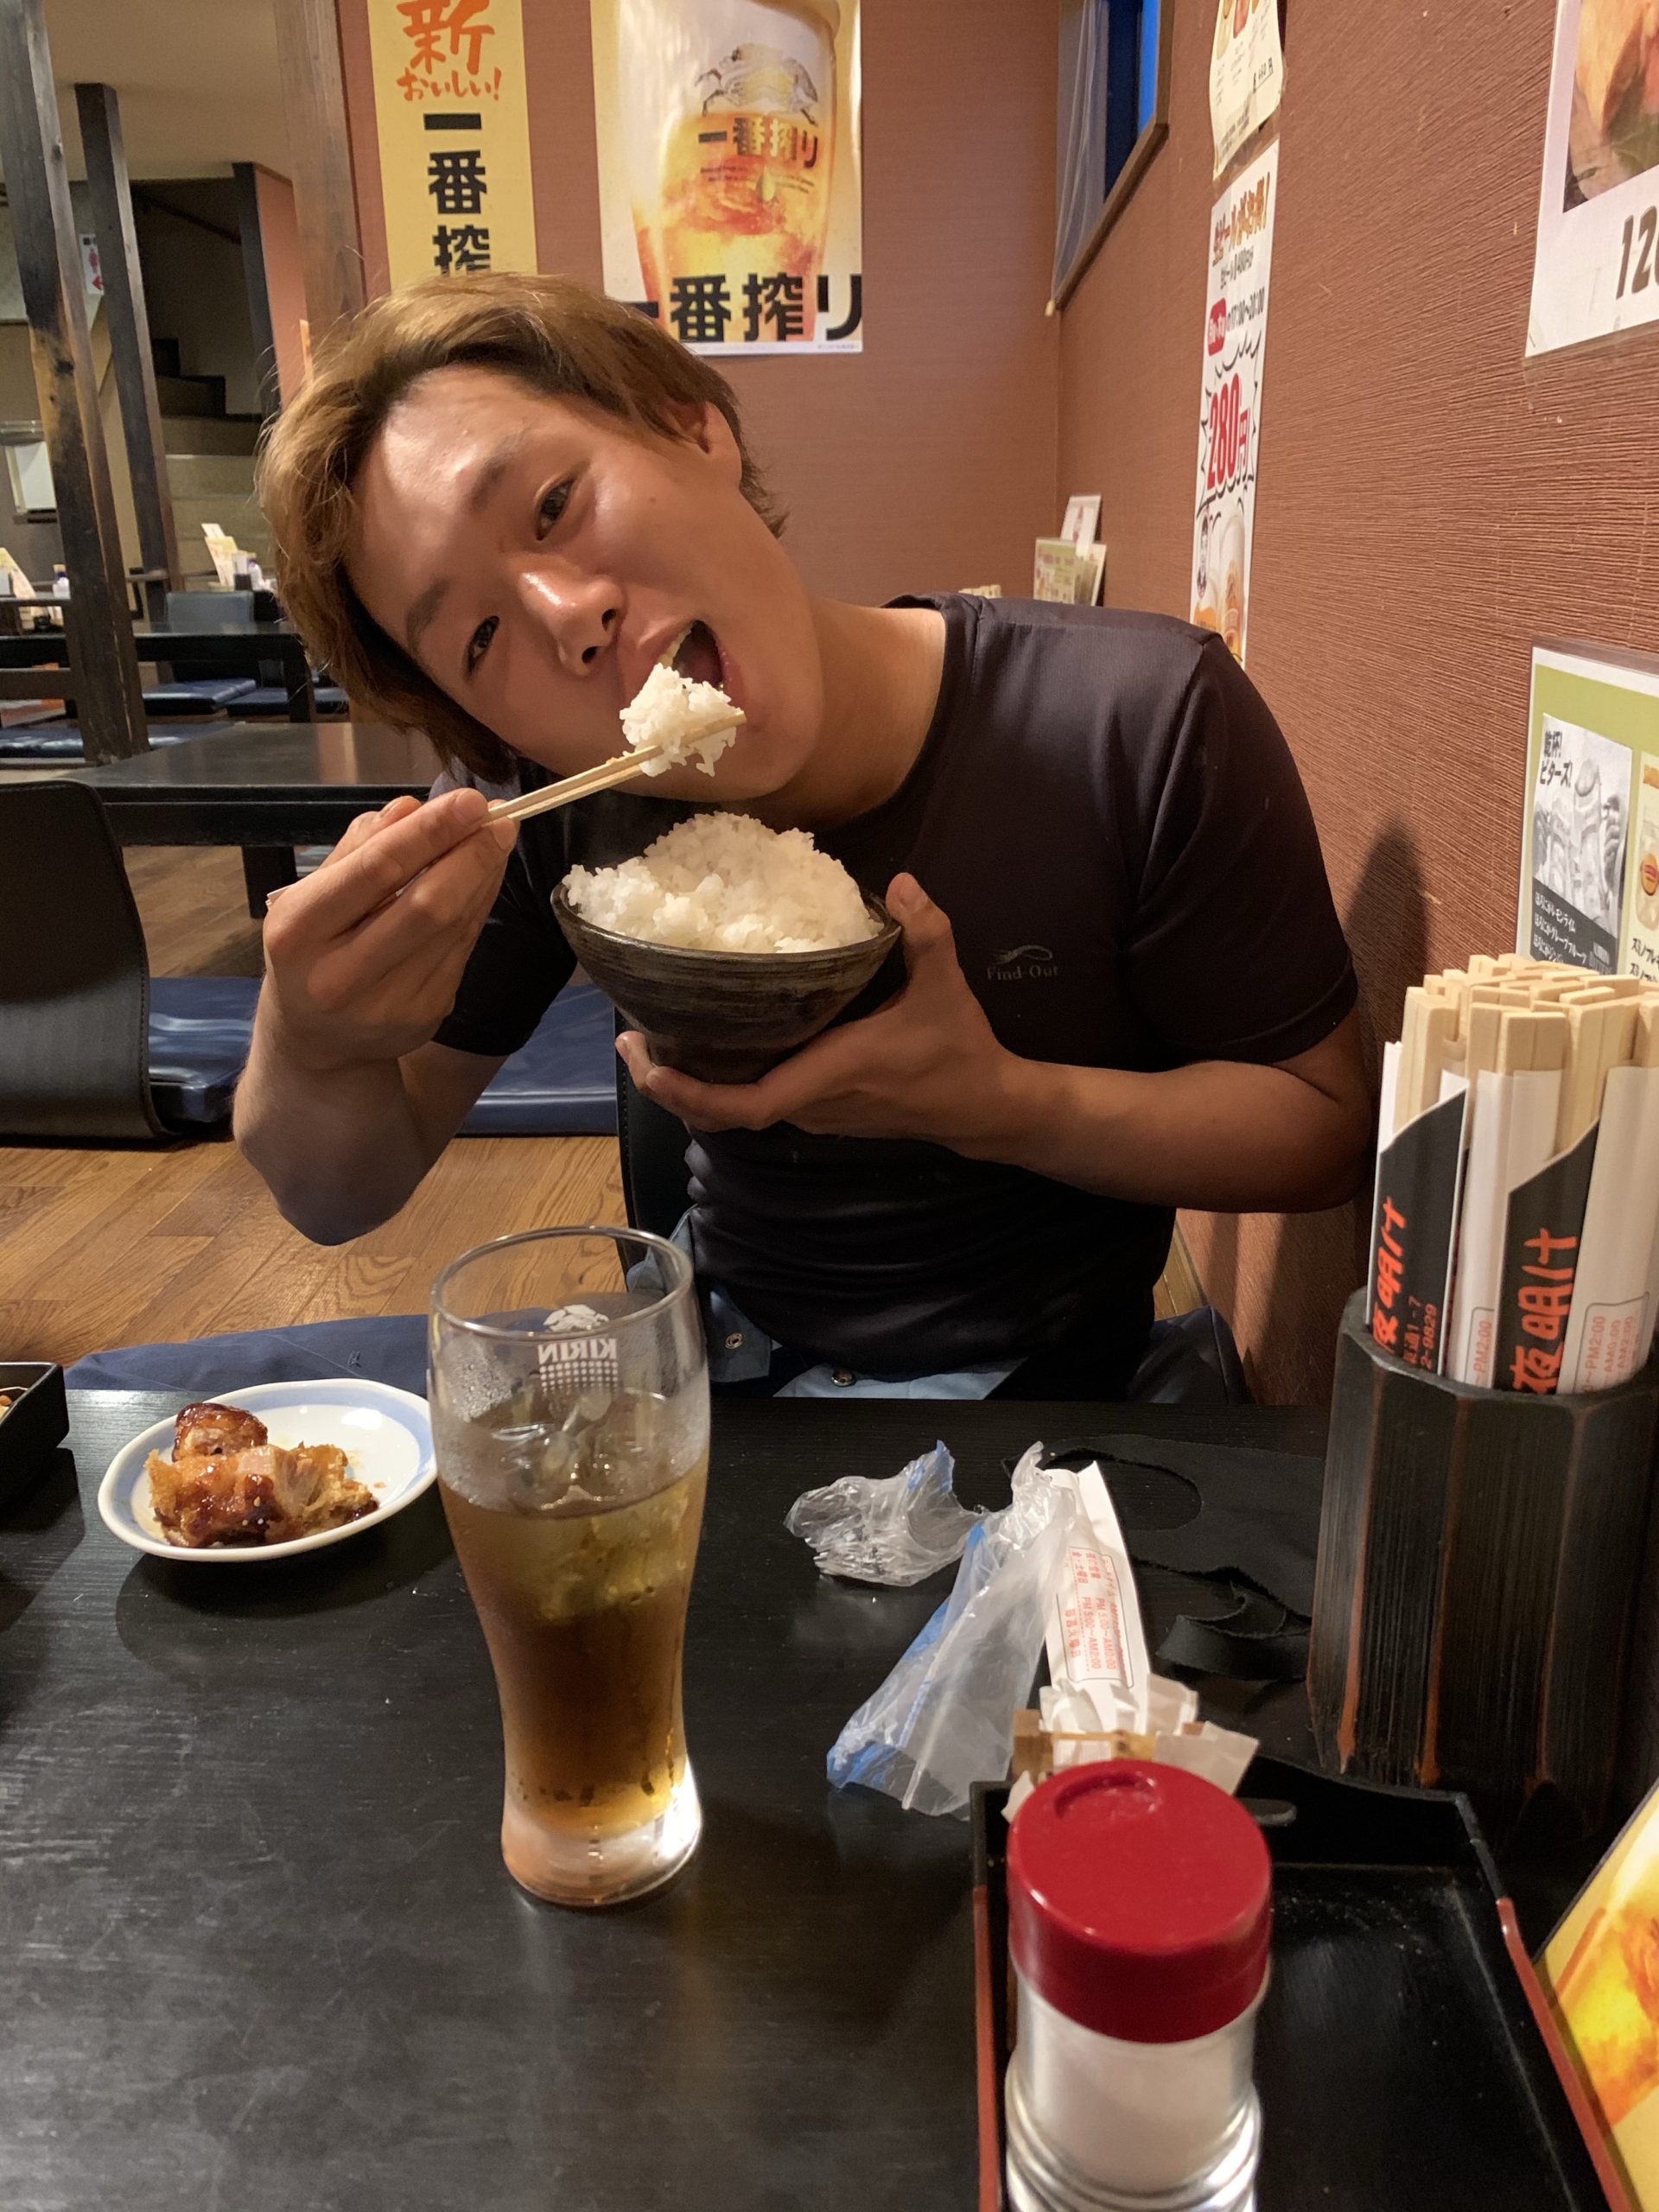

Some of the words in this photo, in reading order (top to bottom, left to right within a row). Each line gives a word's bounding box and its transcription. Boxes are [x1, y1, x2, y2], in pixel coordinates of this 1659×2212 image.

[396, 0, 496, 76] 新
[396, 67, 502, 102] おいしい!
[698, 115, 818, 168] 一番搾り
[1616, 206, 1659, 301] 12
[1207, 372, 1249, 491] 280円
[986, 965, 1022, 980] Find
[1029, 964, 1058, 978] Out
